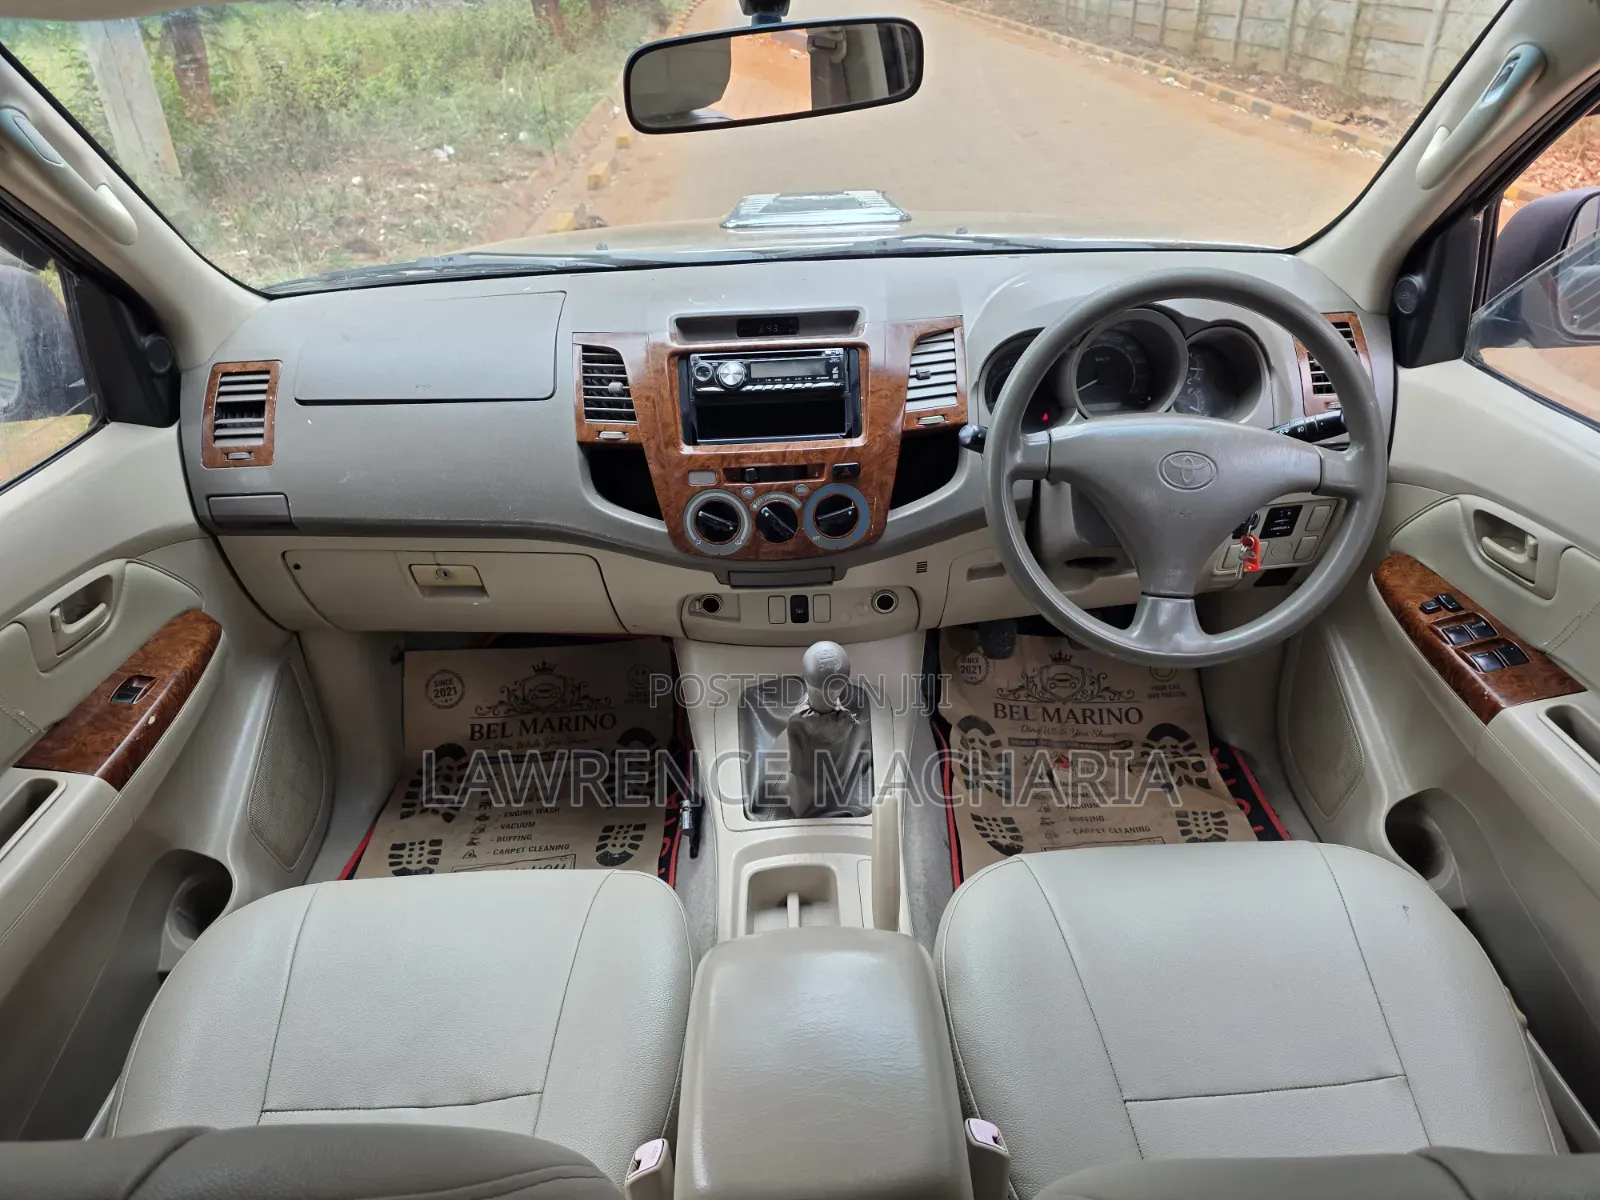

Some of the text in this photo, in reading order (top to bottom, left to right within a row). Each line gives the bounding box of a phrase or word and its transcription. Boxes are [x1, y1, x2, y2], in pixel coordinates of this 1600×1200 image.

[960, 665, 982, 674] 2021
[433, 685, 458, 698] 2021
[992, 702, 1144, 726] BEL MARINO
[468, 712, 618, 742] BEL MARINO
[503, 806, 561, 819] ENGINE WASH
[500, 820, 537, 831] VACUUM
[1109, 825, 1152, 835] CLEANING
[496, 834, 533, 844] BUFFING
[492, 843, 571, 857] CARPET CLEANING
